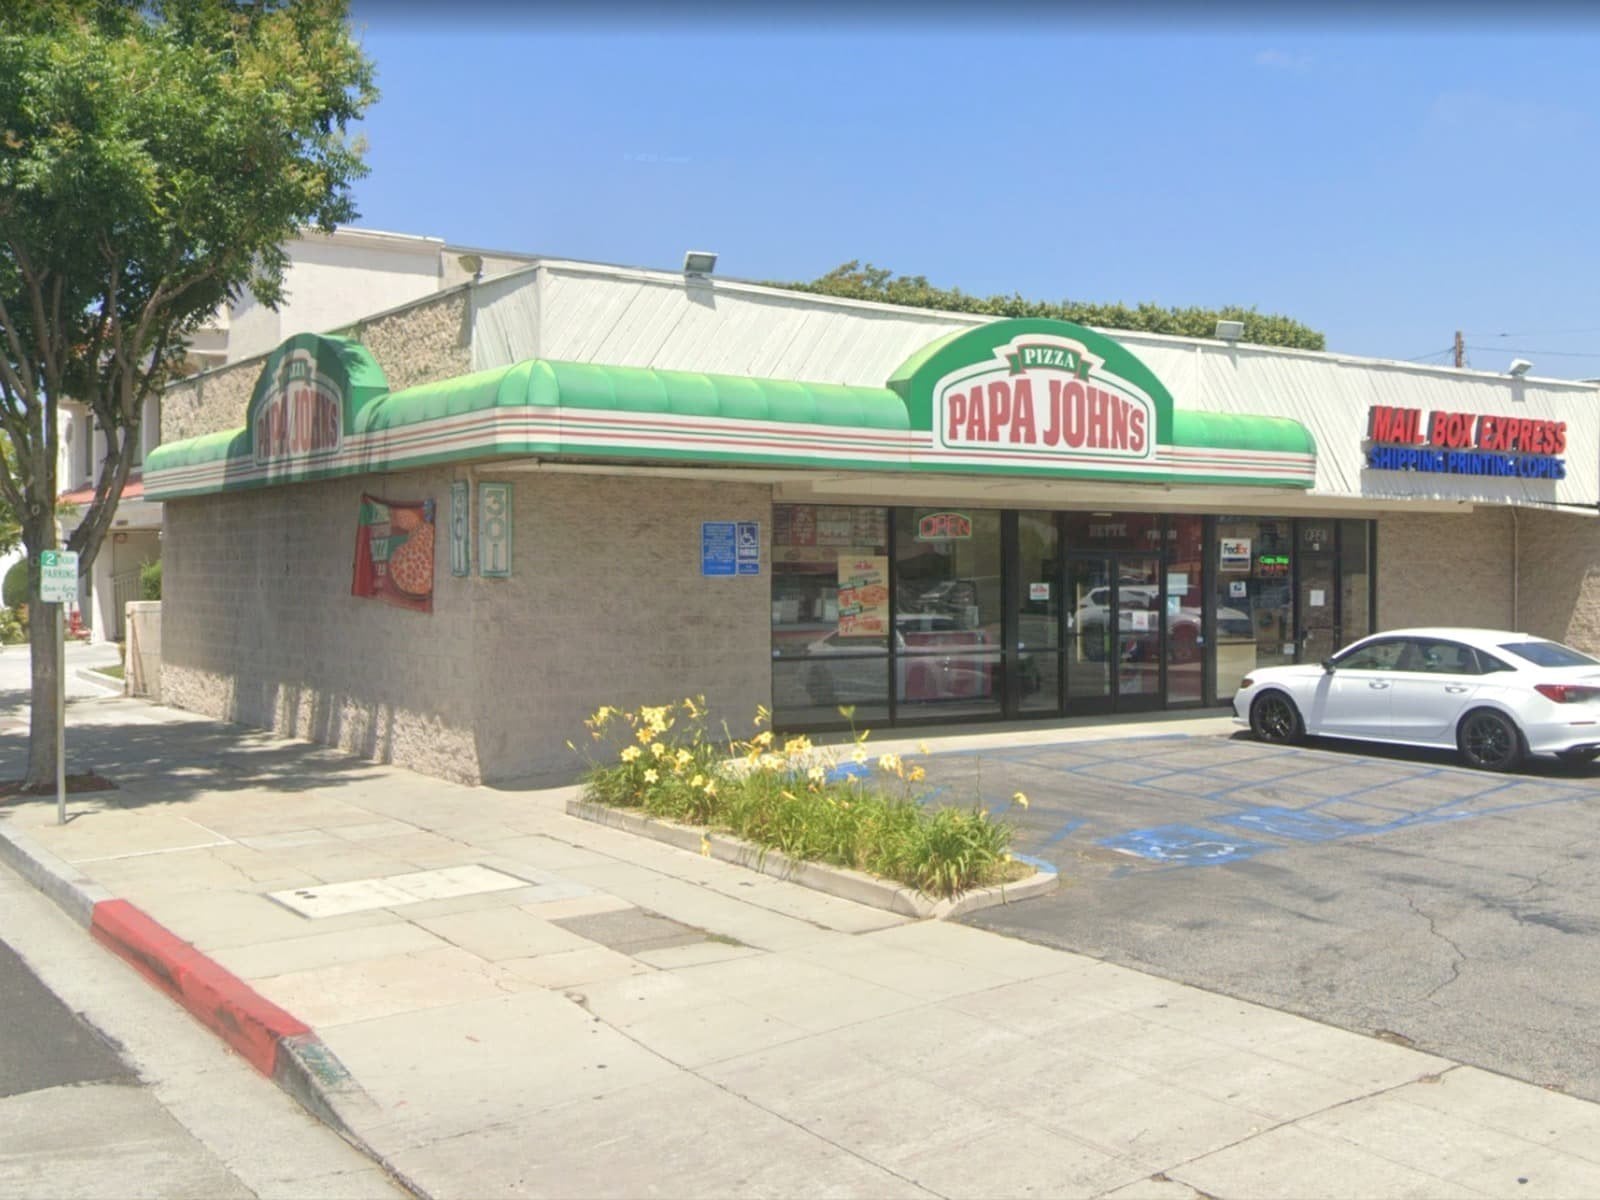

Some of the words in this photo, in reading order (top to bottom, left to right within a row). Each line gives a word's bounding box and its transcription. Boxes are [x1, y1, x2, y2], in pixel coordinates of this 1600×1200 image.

[1024, 347, 1075, 368] PIZZA
[948, 378, 1037, 444] PAPA
[1370, 405, 1425, 444] MAIL
[1430, 410, 1476, 448] BOX
[1478, 415, 1567, 454] EXPRESS
[1370, 445, 1444, 472] SHIPPING
[1448, 451, 1515, 477] PRINTING
[1519, 456, 1567, 480] COPIES
[921, 514, 970, 537] OPEN
[46, 553, 55, 565] 2
[1223, 543, 1249, 555] FedEx
[44, 569, 76, 578] PARKING
